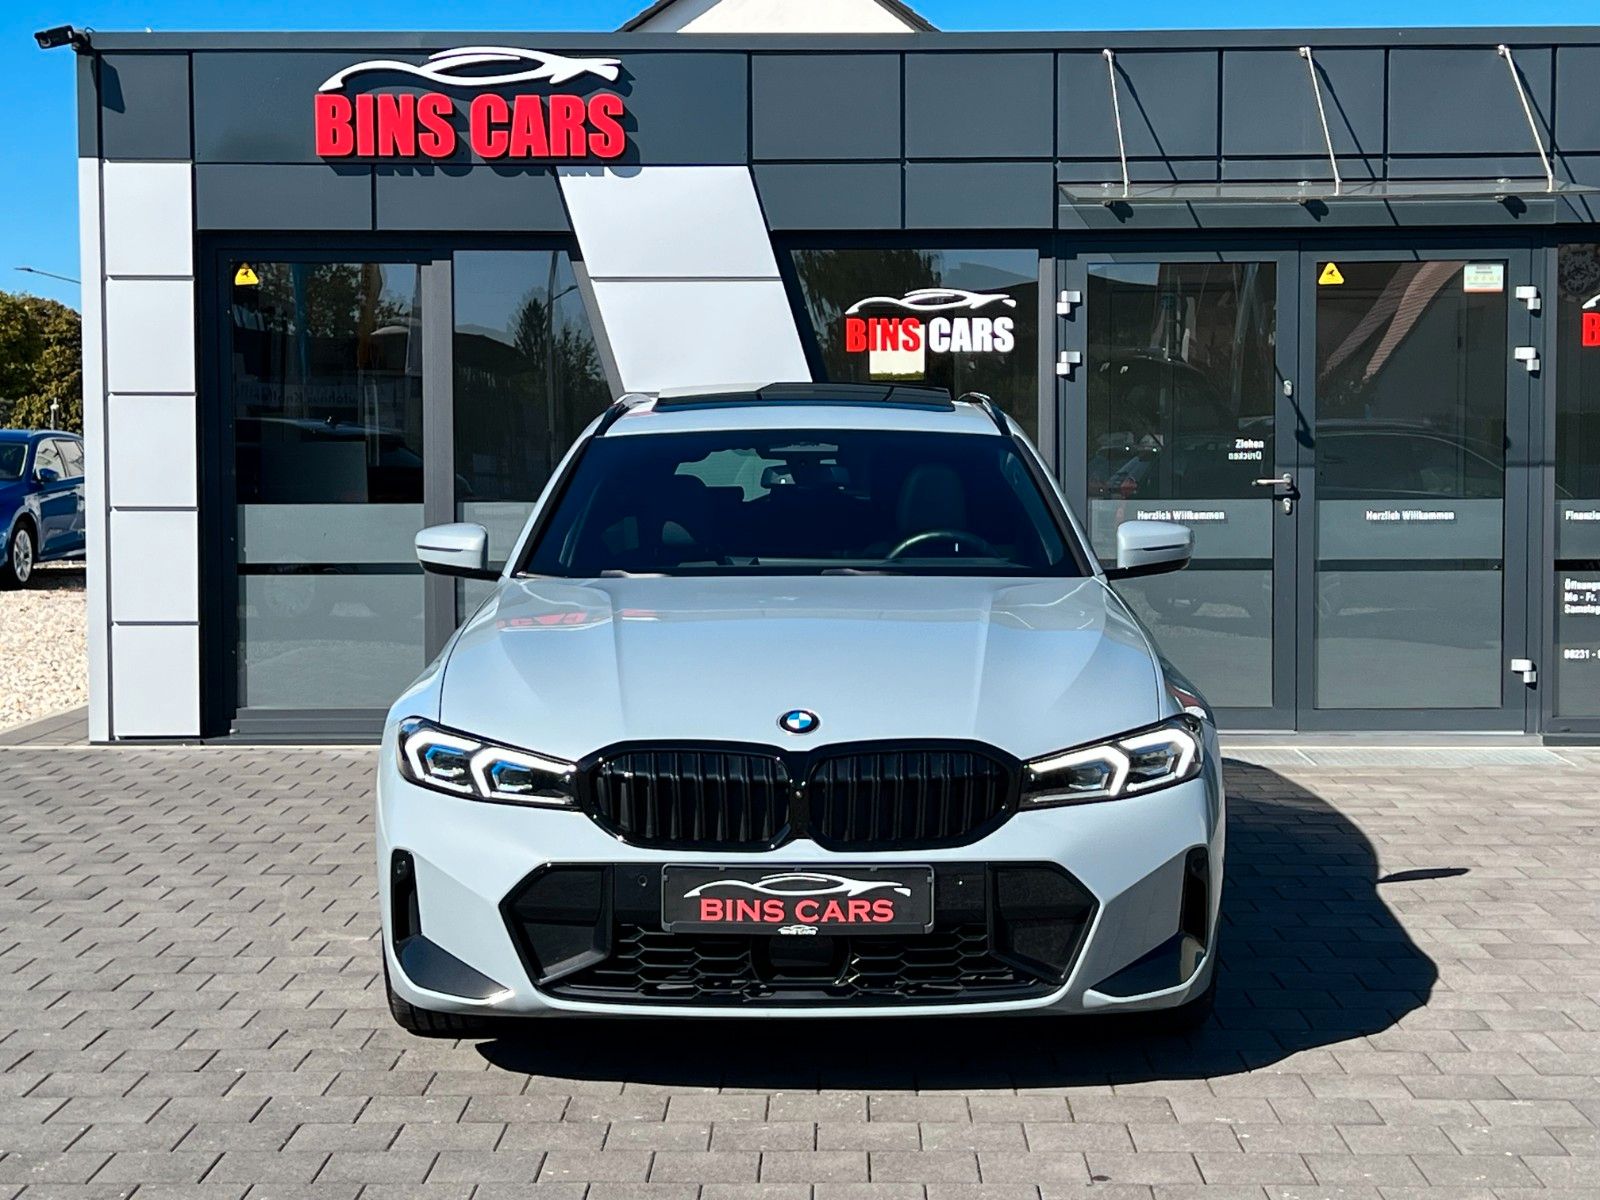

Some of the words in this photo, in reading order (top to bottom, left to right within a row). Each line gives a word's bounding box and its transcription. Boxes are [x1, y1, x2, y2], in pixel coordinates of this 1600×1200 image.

[314, 93, 456, 158] BINS
[469, 93, 626, 158] CARS
[845, 316, 921, 353] BINS
[928, 316, 1015, 353] CARS
[1235, 438, 1264, 449] Ziehen
[1137, 510, 1171, 520] Herzlich
[1172, 510, 1225, 520] Willkommen
[1365, 510, 1400, 520] Herzlich
[1401, 510, 1455, 520] Willkommen
[1585, 592, 1597, 601] Fr.
[700, 899, 785, 922] BINS
[795, 899, 895, 922] CARS
